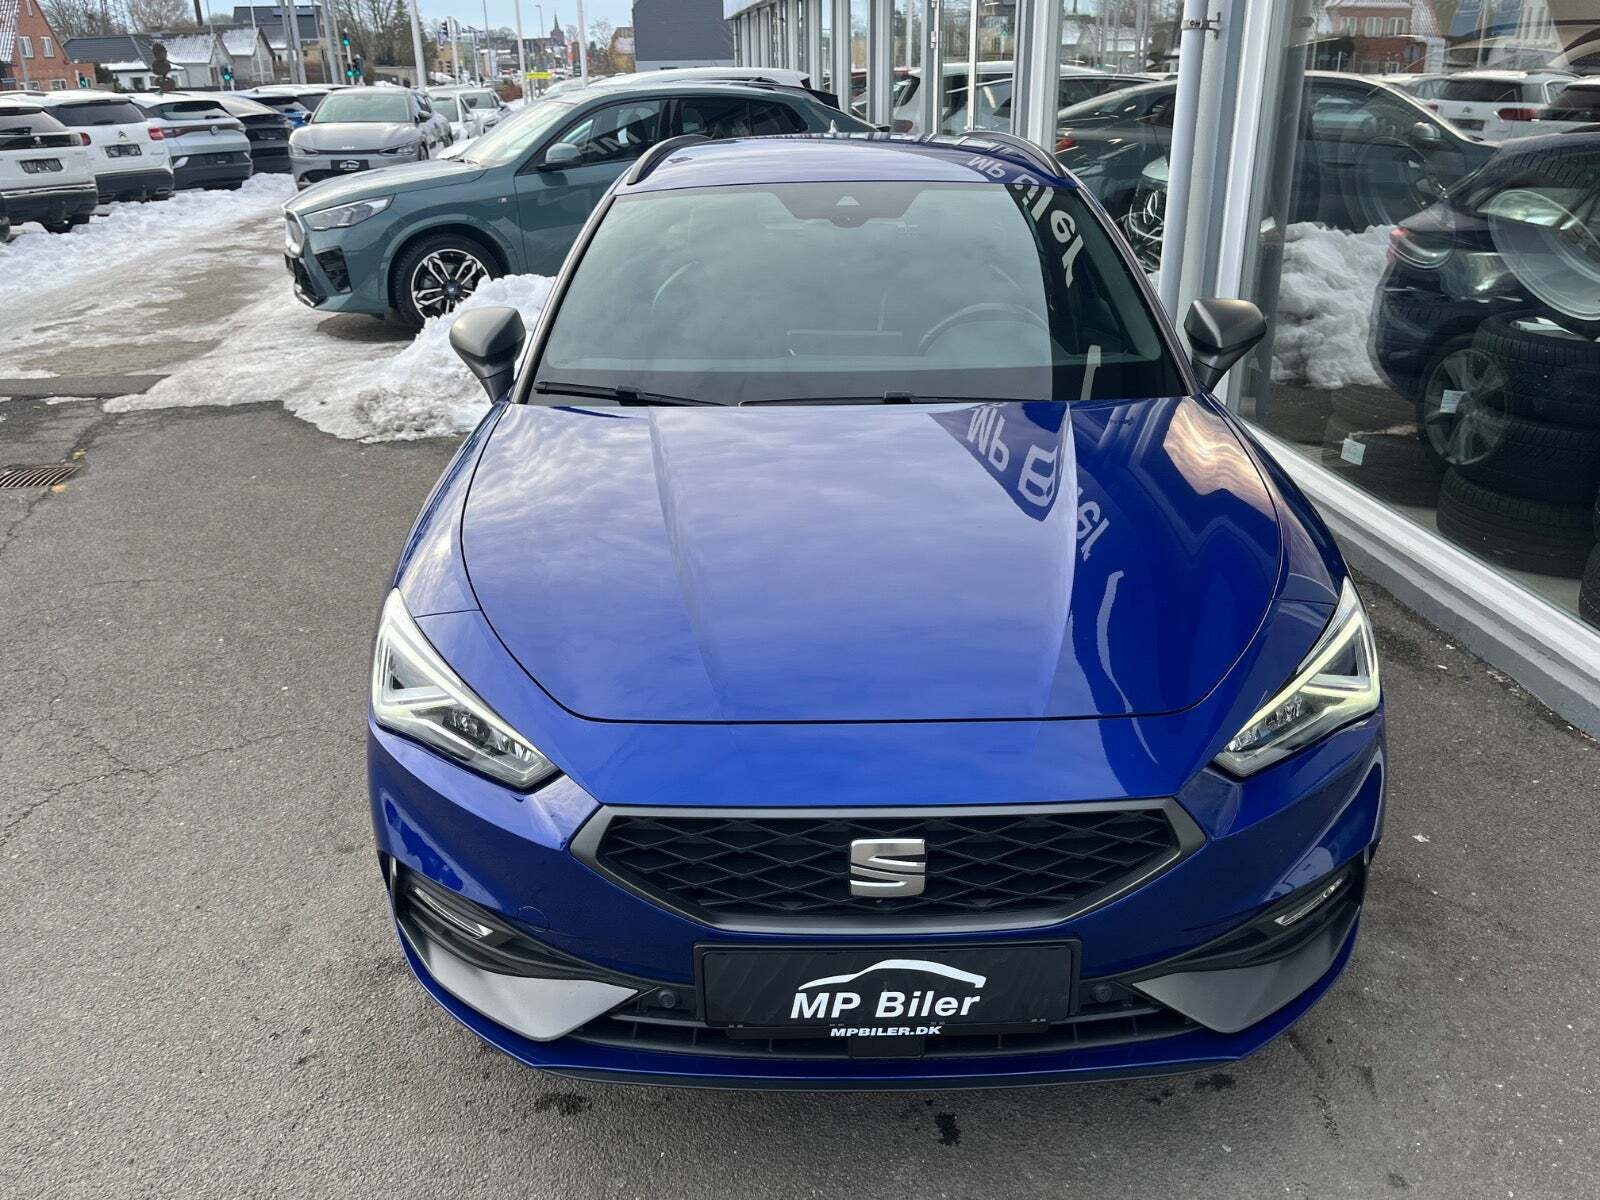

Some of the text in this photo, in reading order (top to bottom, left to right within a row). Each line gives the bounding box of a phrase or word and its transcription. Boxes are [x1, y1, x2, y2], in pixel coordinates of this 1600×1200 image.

[790, 990, 980, 1019] MP Biler
[830, 1026, 941, 1037] MPBILER.DK
